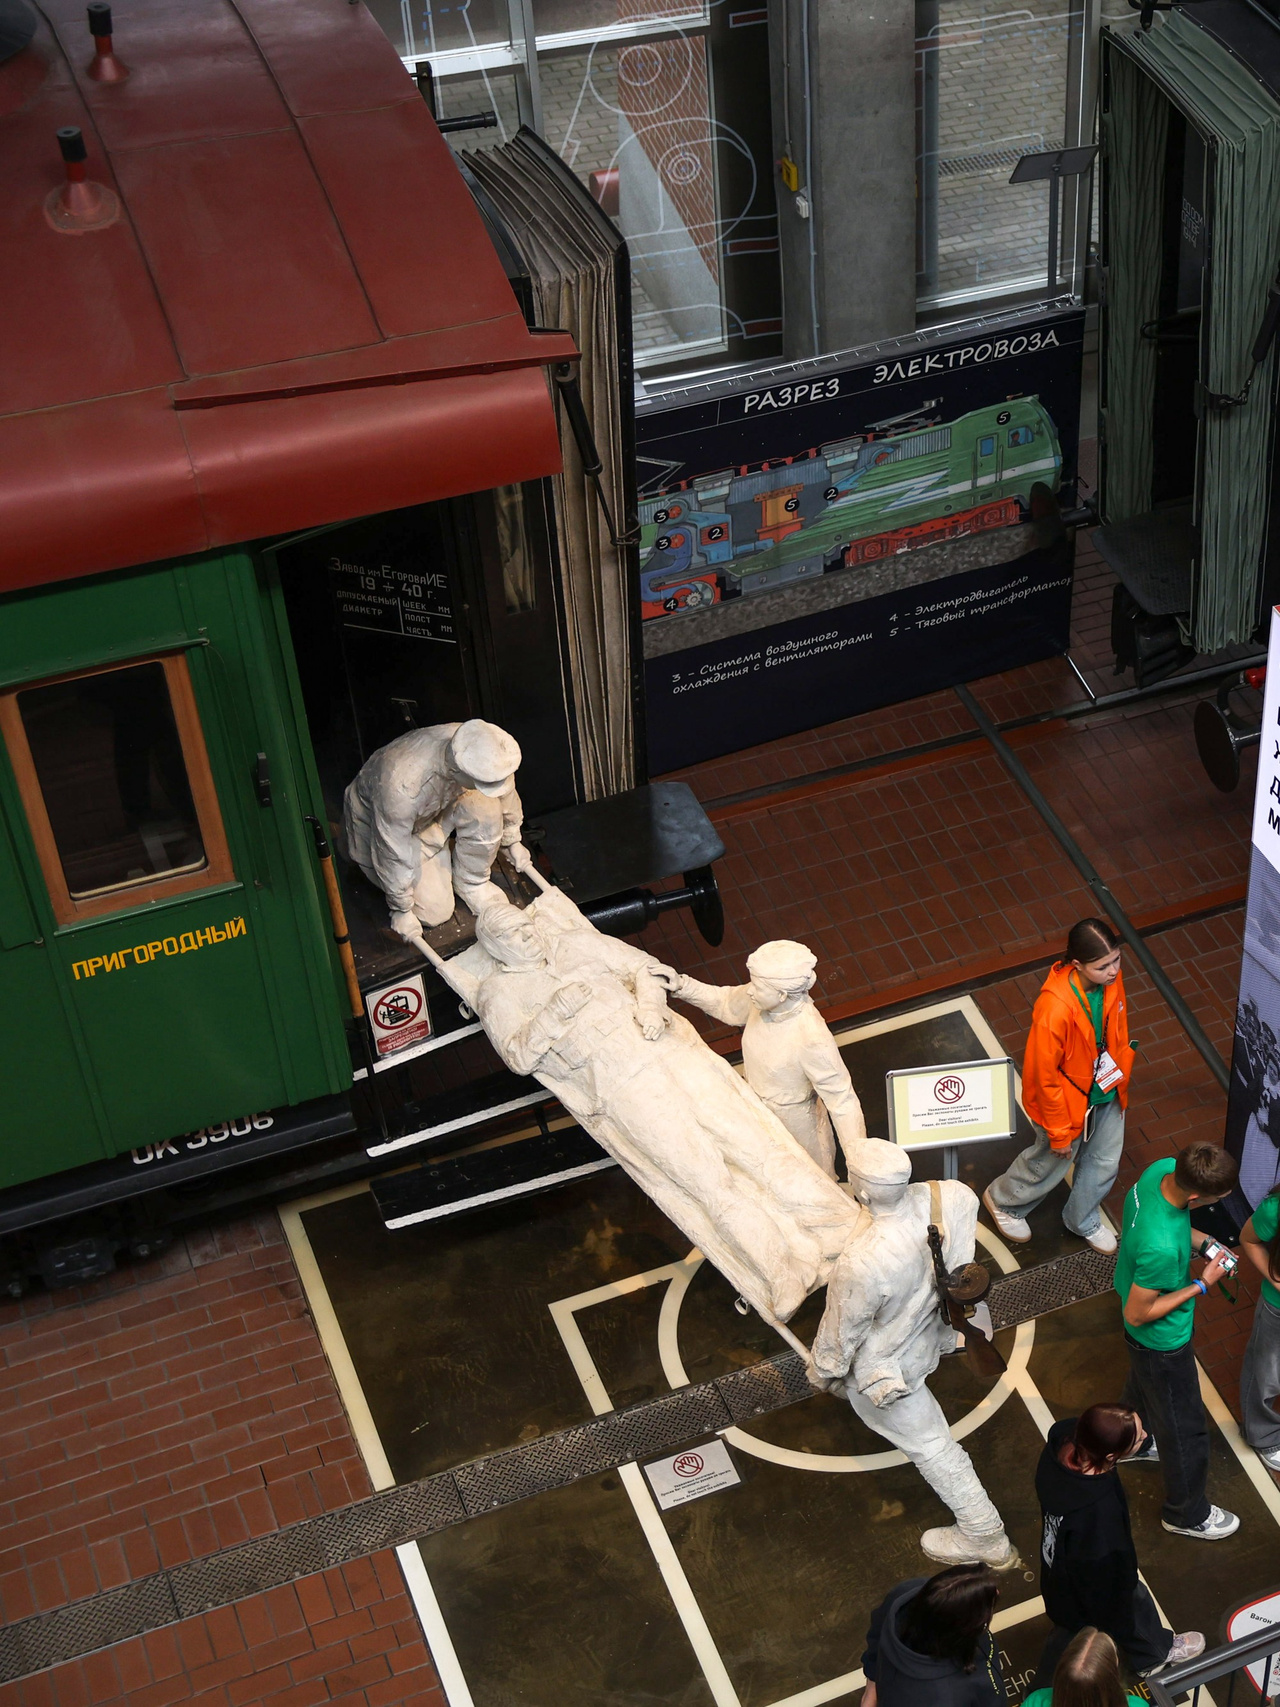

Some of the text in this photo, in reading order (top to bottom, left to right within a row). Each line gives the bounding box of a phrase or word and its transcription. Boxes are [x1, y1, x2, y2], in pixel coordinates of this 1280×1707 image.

[744, 329, 1060, 413] РАЗРЕЗ ЭЛЕКТРОВОЗА
[360, 576, 376, 591] 19
[401, 583, 422, 598] 40
[915, 575, 1029, 616] Электродвигатель
[915, 609, 966, 629] Тяговый
[672, 666, 749, 695] охлаждения
[765, 632, 873, 668] вентиляторами
[700, 652, 762, 675] Система
[766, 630, 839, 656] воздушного
[72, 916, 246, 981] ПРИГОРОДНЫЙ
[1250, 1612, 1272, 1625] Вагон
